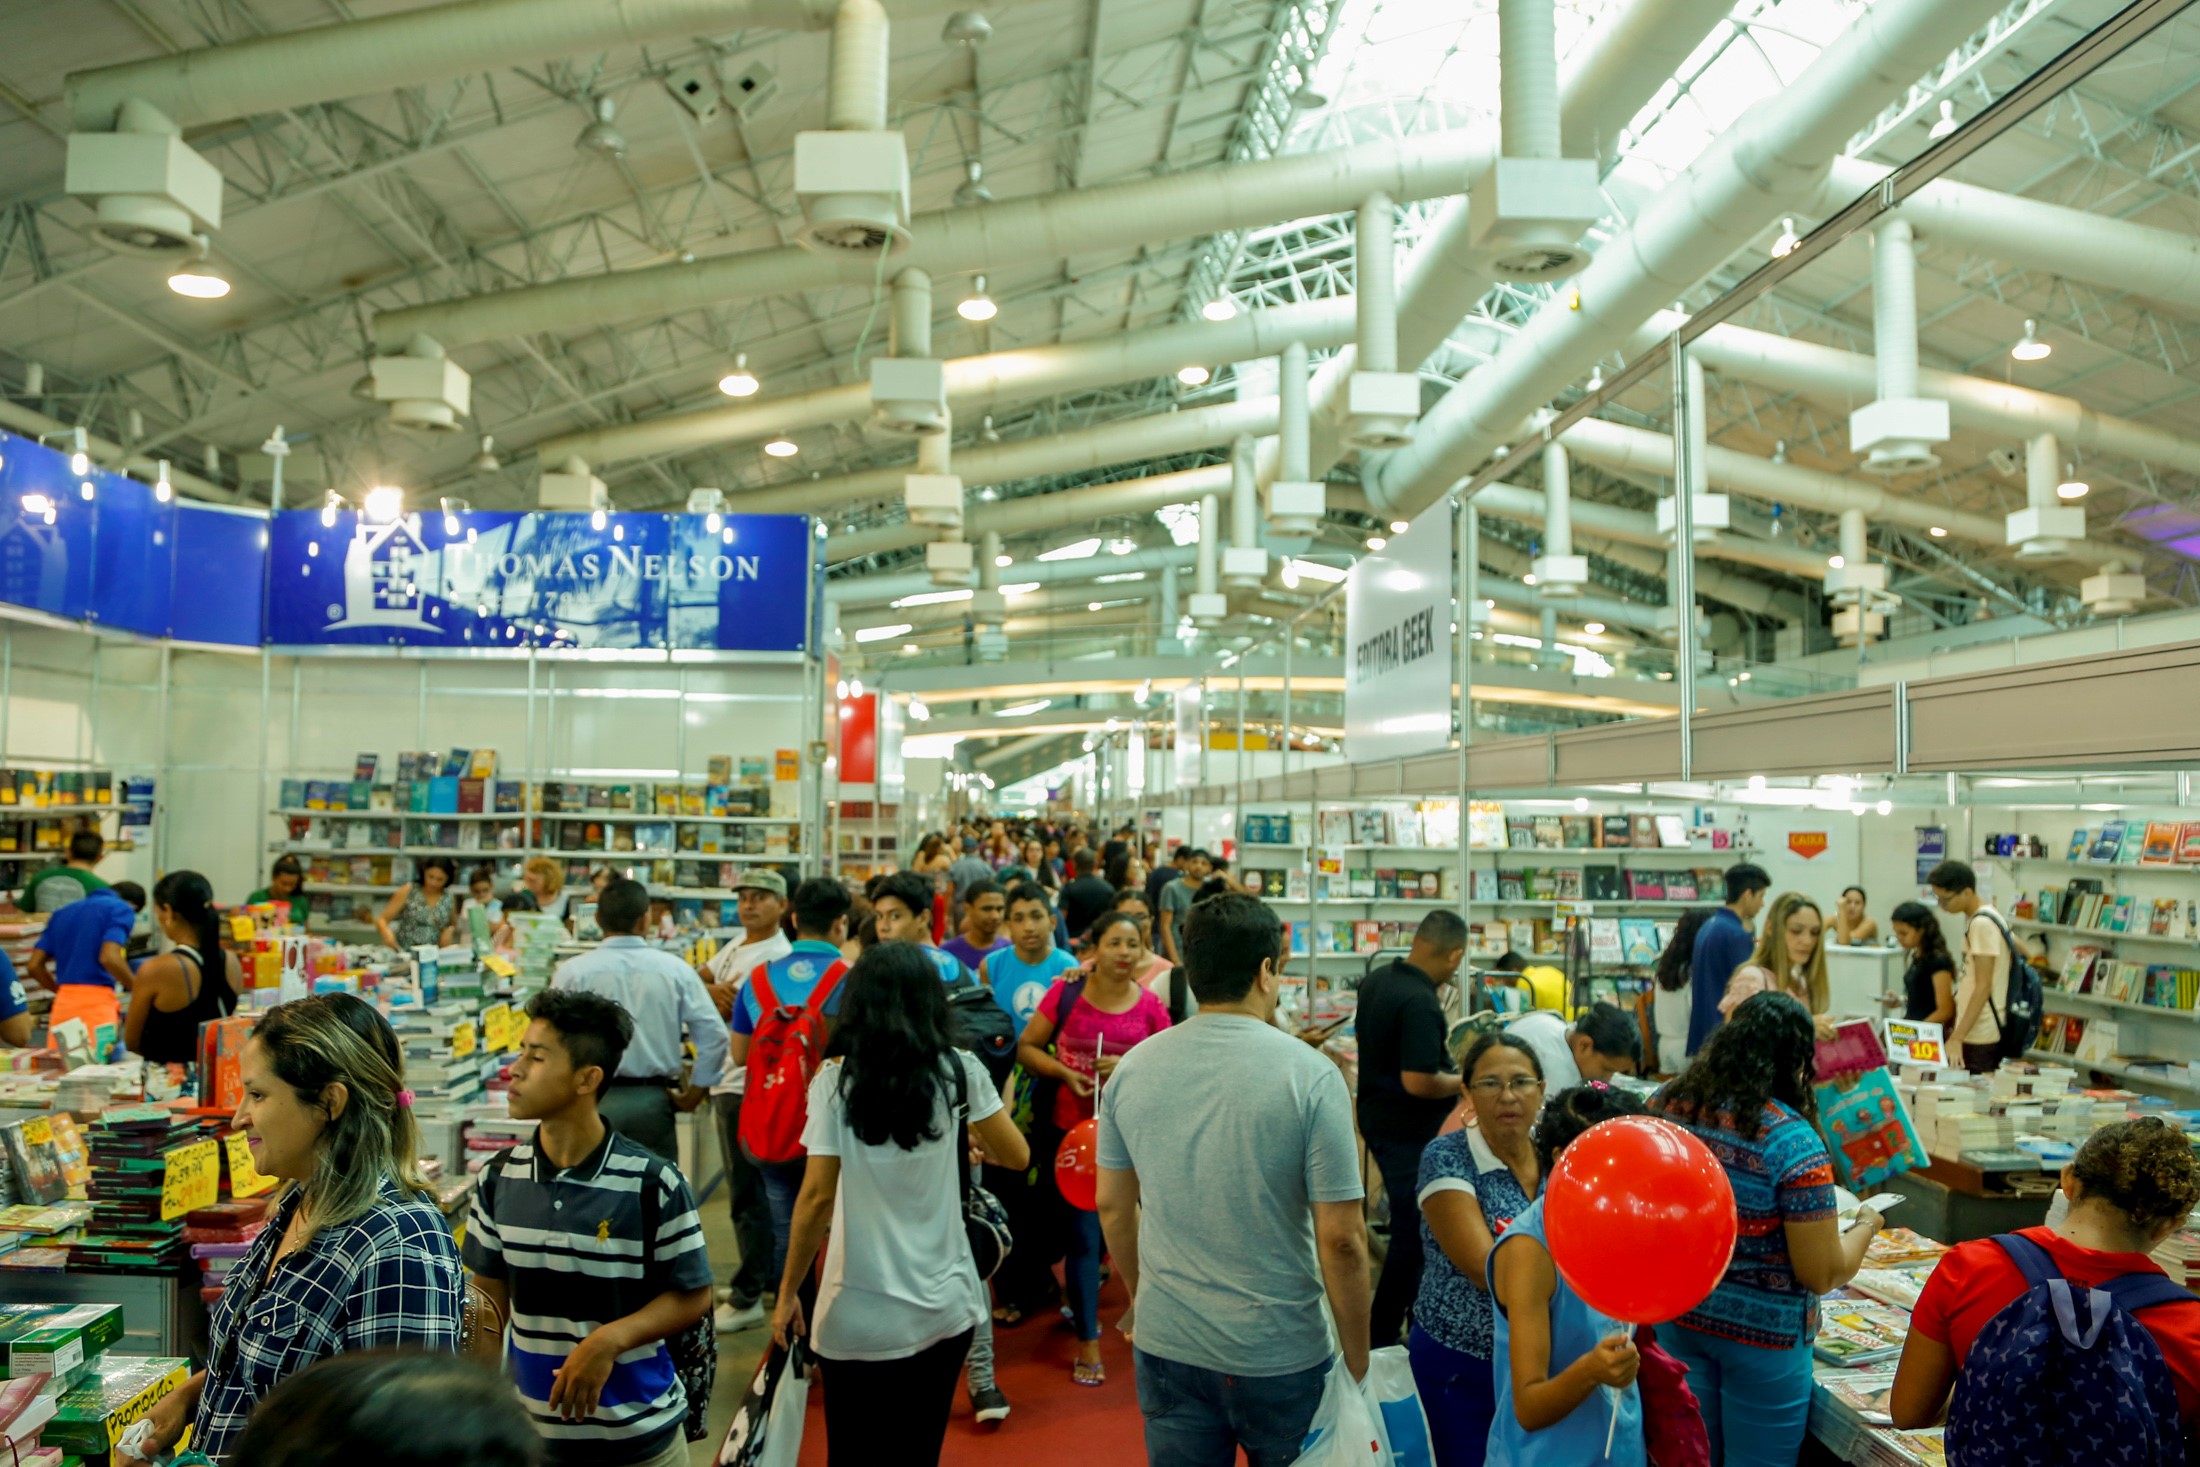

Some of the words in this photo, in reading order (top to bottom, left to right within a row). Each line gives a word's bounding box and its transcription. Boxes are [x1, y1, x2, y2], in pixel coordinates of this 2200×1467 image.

[444, 543, 600, 580] THOMAS
[606, 545, 760, 581] NELSON
[1357, 625, 1400, 684] EDITORA
[1403, 604, 1434, 665] GEEK
[1791, 834, 1825, 846] CAIXA
